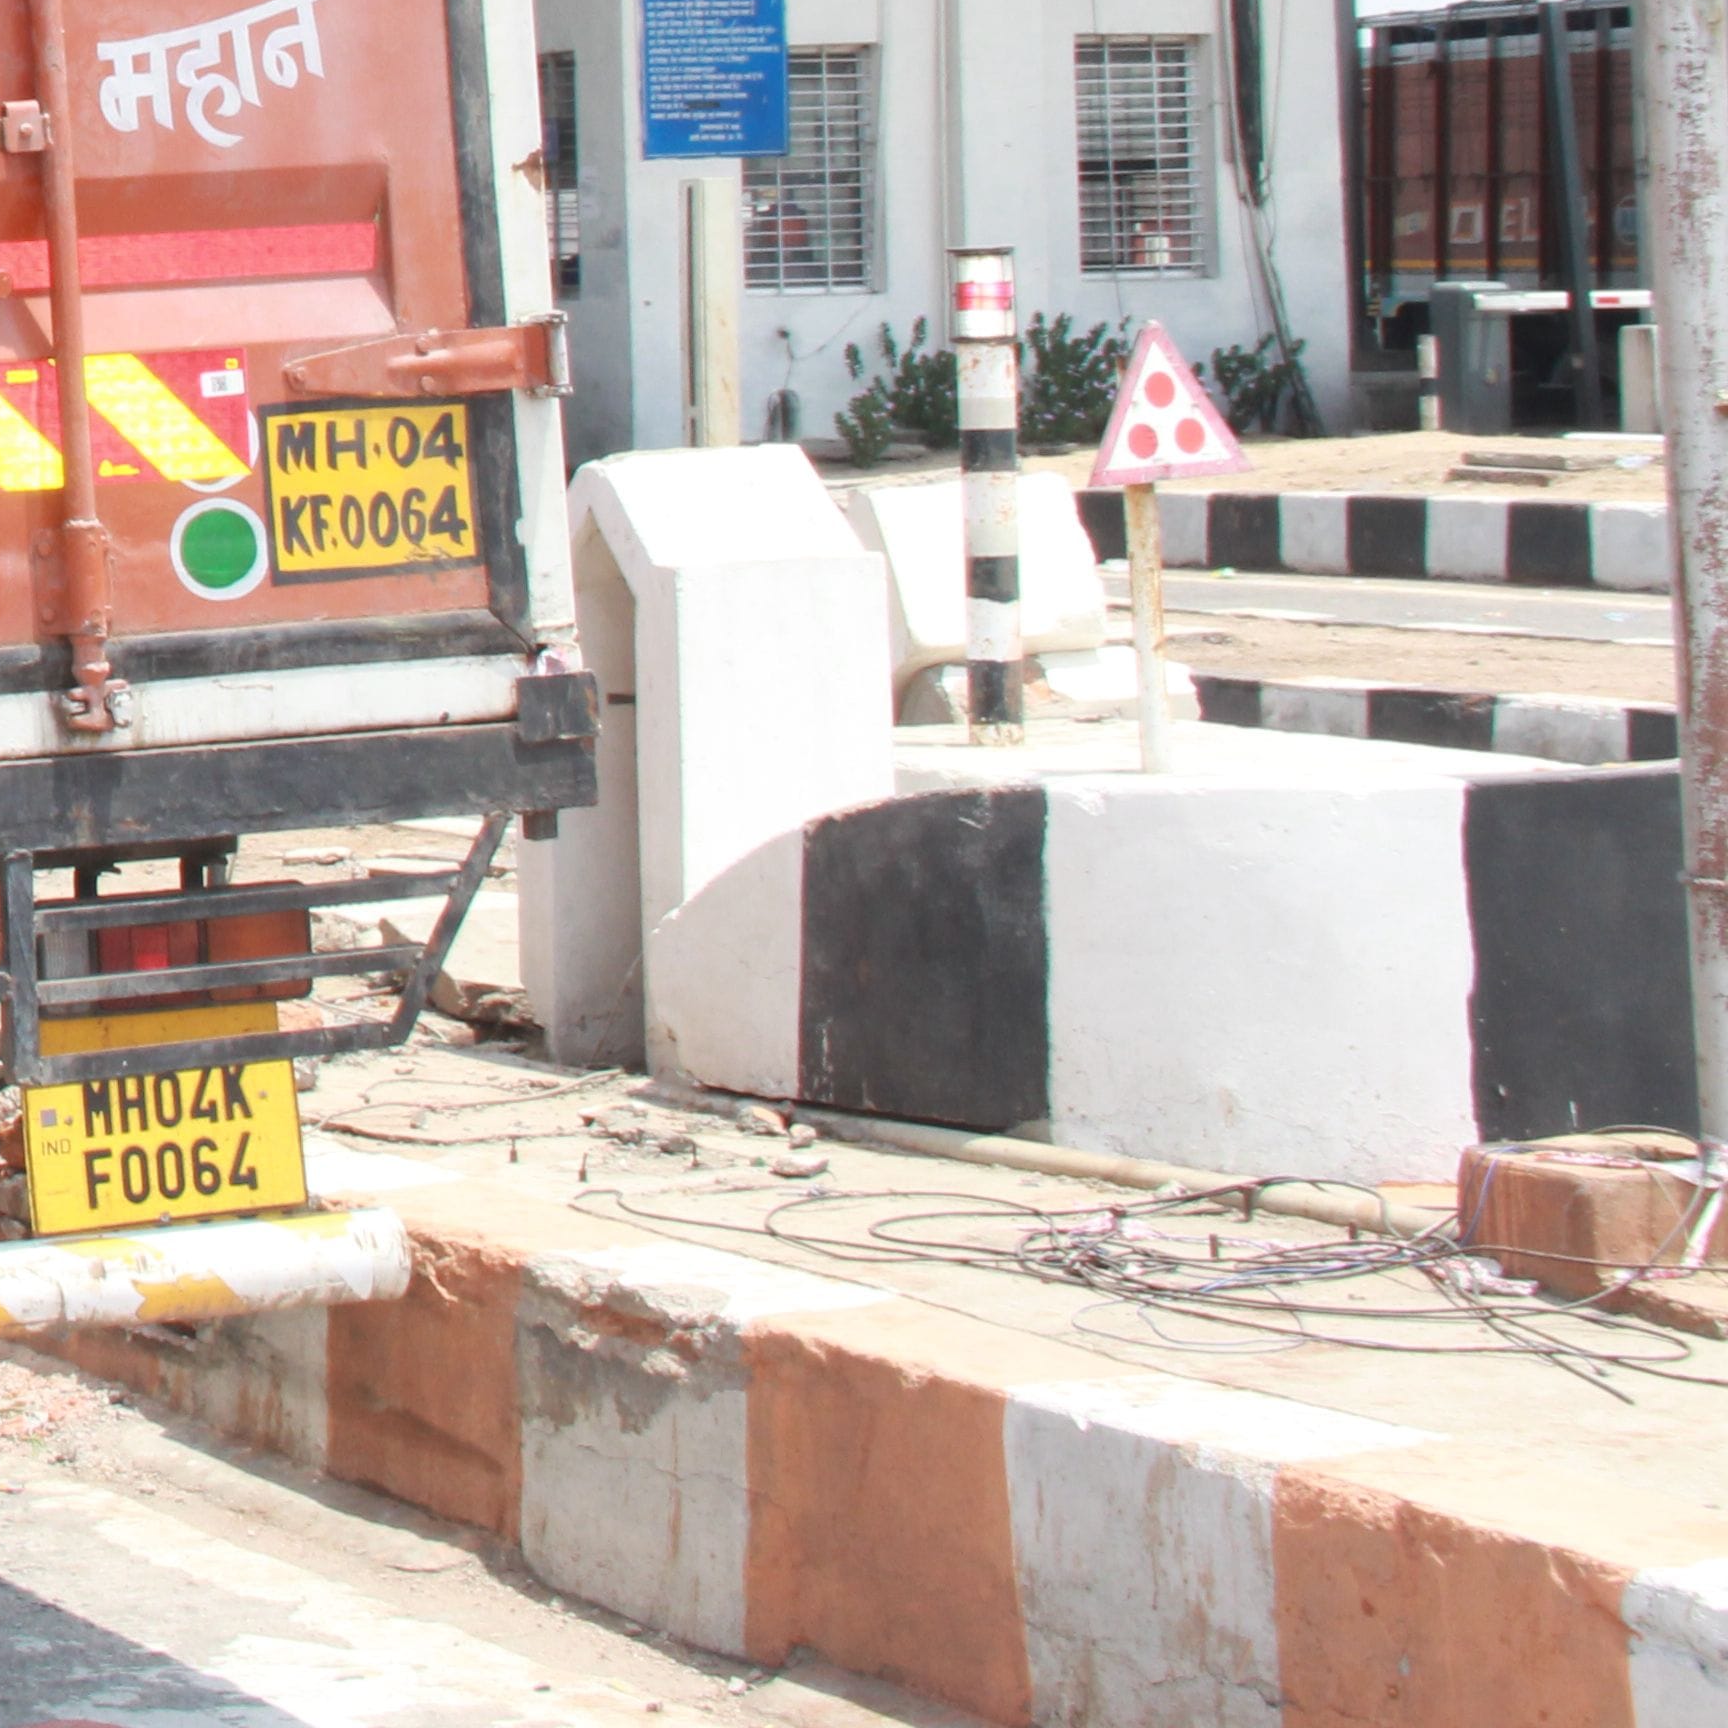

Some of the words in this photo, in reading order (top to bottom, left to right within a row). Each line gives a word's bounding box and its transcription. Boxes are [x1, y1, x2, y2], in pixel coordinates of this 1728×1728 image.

[81, 1066, 253, 1139] MH04K
[41, 1138, 72, 1157] IND
[83, 1131, 259, 1210] F0064
